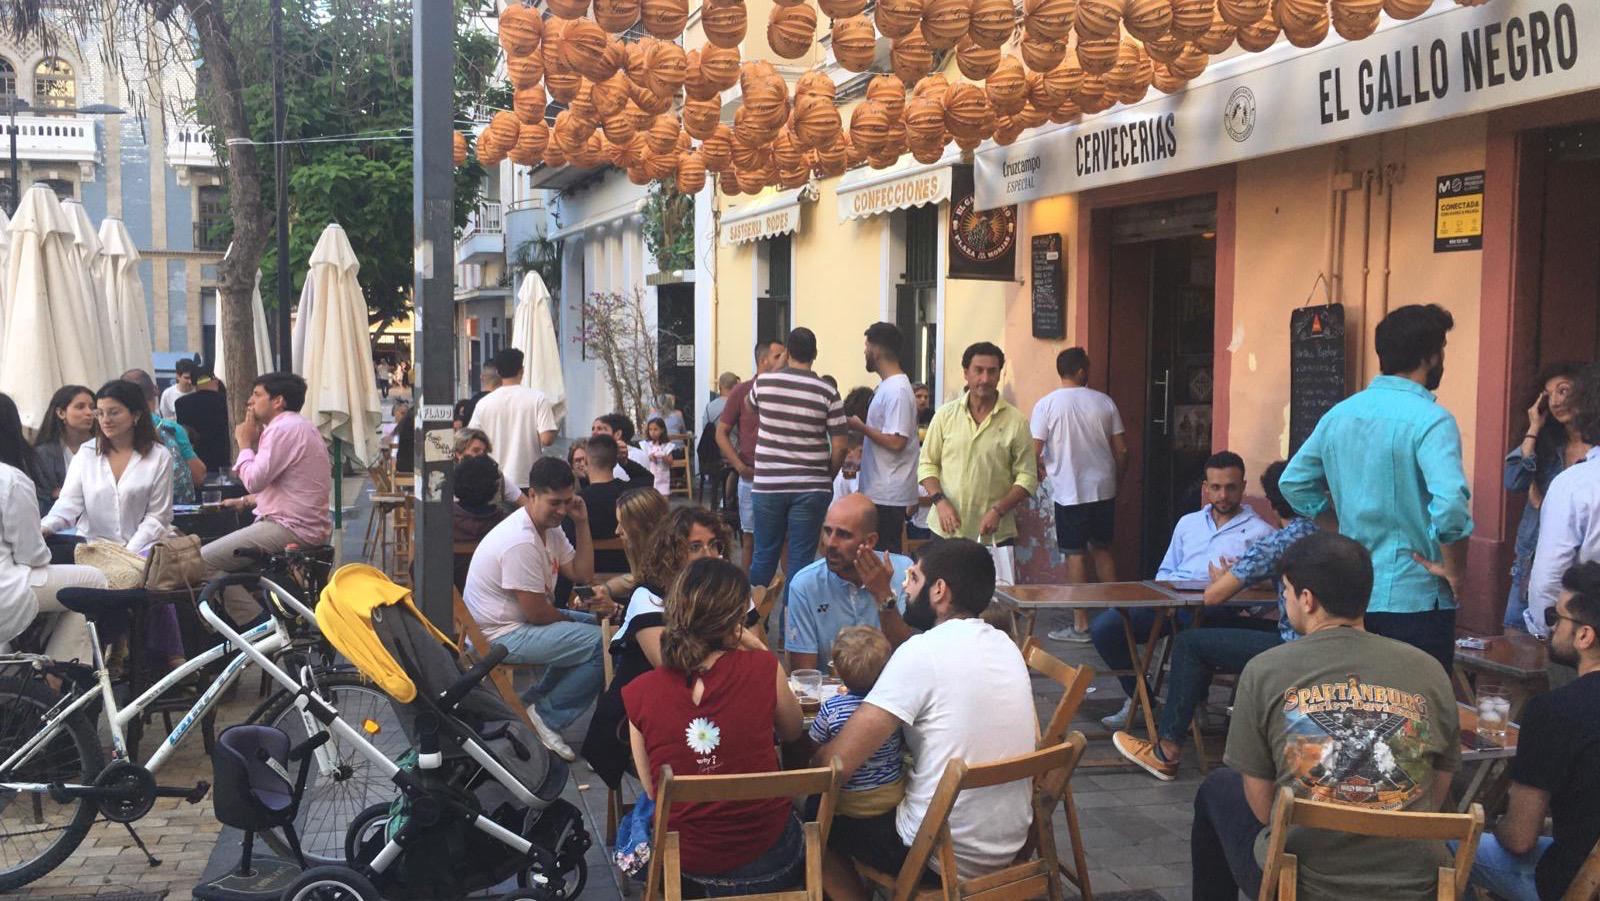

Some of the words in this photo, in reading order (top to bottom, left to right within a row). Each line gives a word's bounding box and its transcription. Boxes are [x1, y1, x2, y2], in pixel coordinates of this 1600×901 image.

[1319, 67, 1350, 125] EL
[1358, 38, 1449, 116] GALLO
[1461, 3, 1578, 92] NEGRO
[1075, 112, 1177, 177] CERVECERIAS
[1002, 155, 1041, 178] Cruzcampo
[853, 175, 938, 213] CONFECCIONES
[1007, 177, 1035, 193] ESPECIAL
[1440, 200, 1479, 211] CONECTADA
[955, 235, 975, 258] PLAZA
